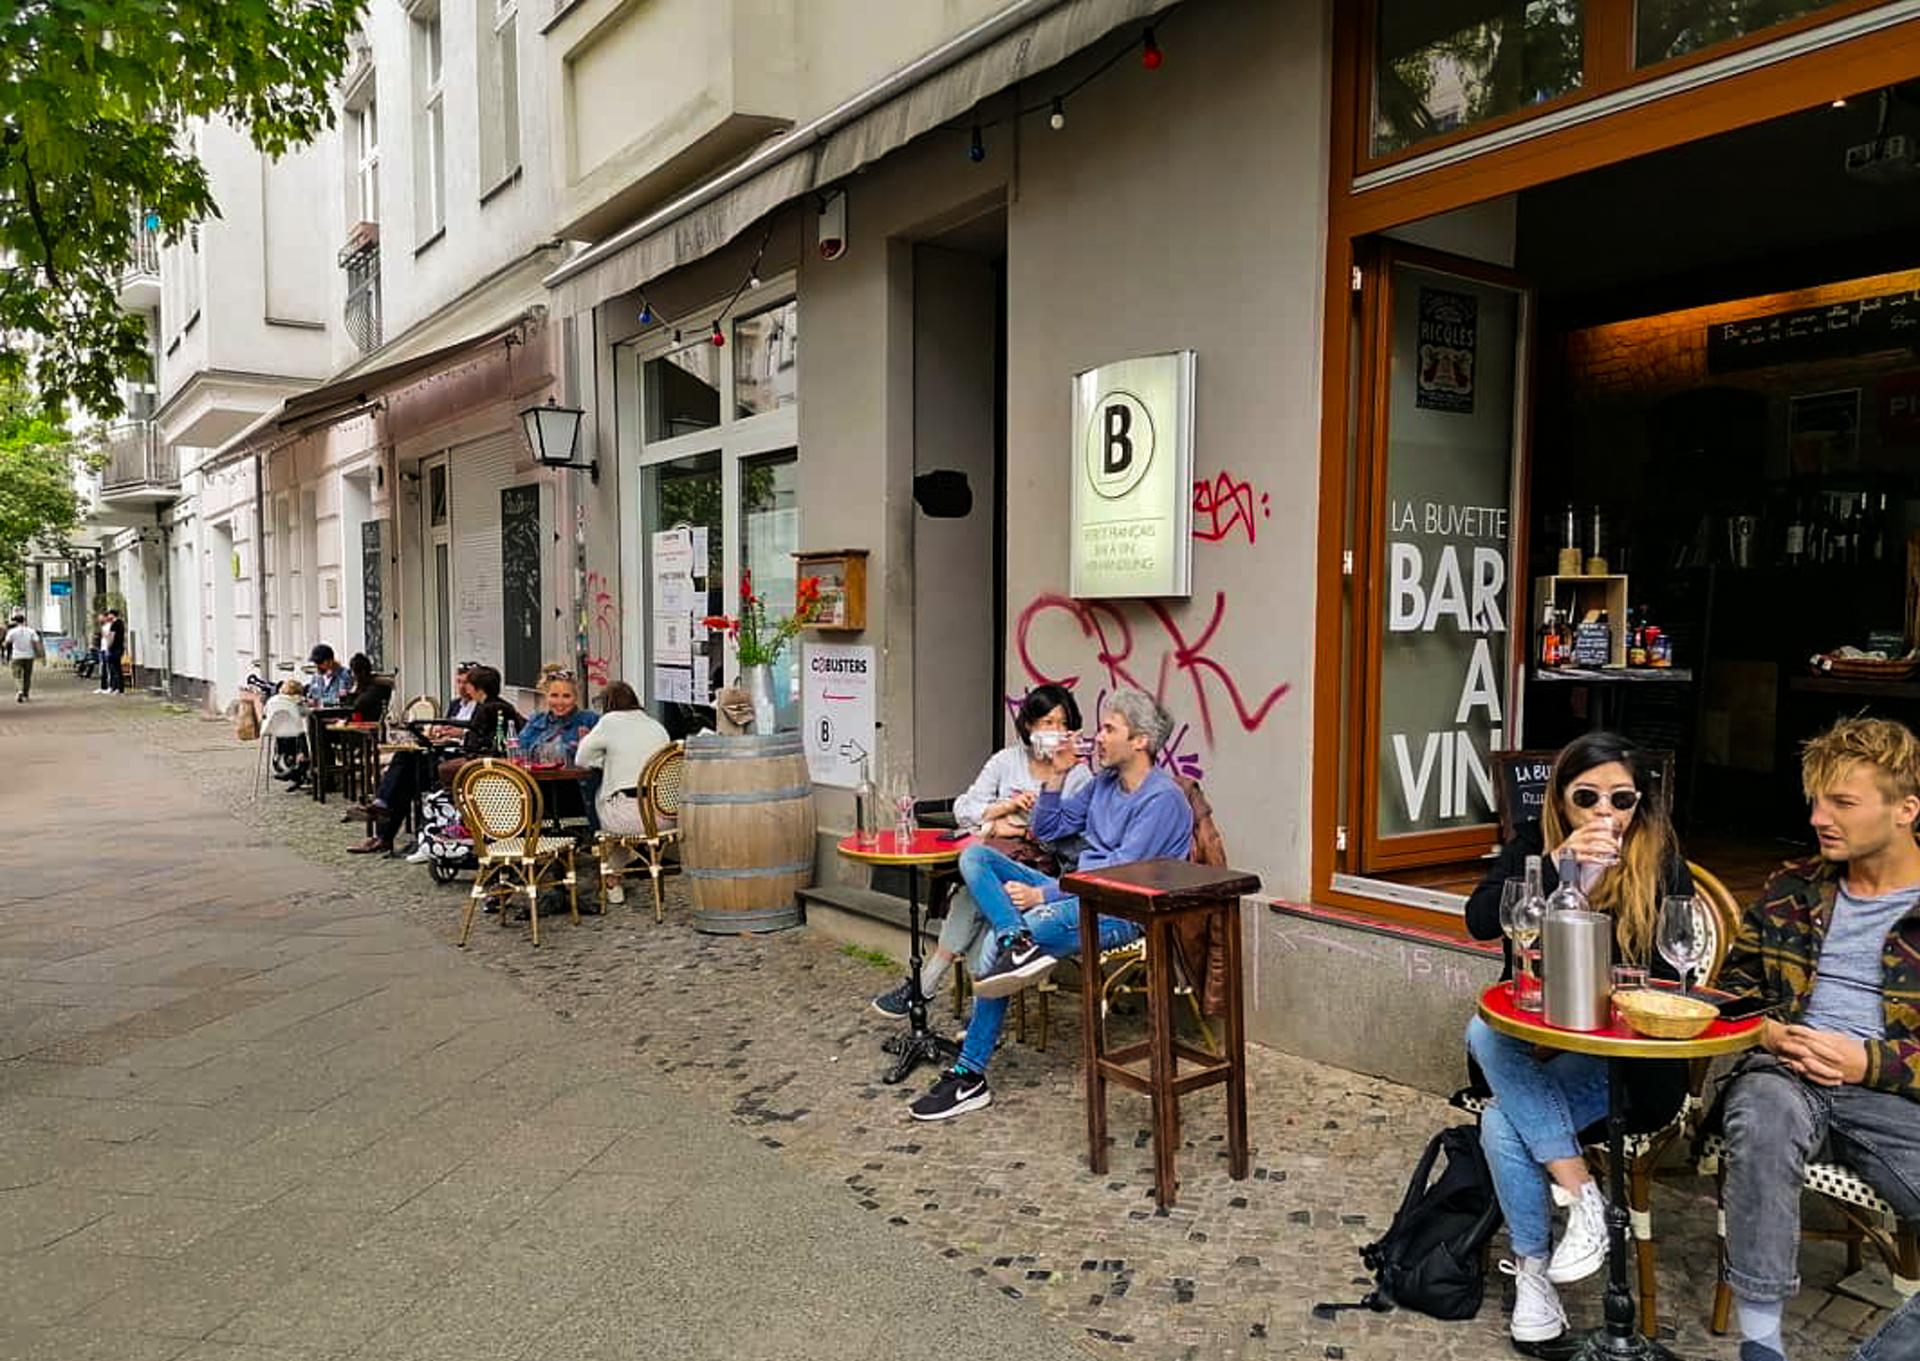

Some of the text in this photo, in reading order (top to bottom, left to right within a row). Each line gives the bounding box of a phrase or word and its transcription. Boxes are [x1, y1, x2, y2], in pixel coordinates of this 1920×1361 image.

[1104, 404, 1133, 475] B
[1393, 500, 1508, 539] LA BUVETTE
[1389, 543, 1507, 634] BAR
[821, 720, 829, 742] B
[1392, 728, 1502, 822] VIN
[1515, 766, 1531, 783] LA
